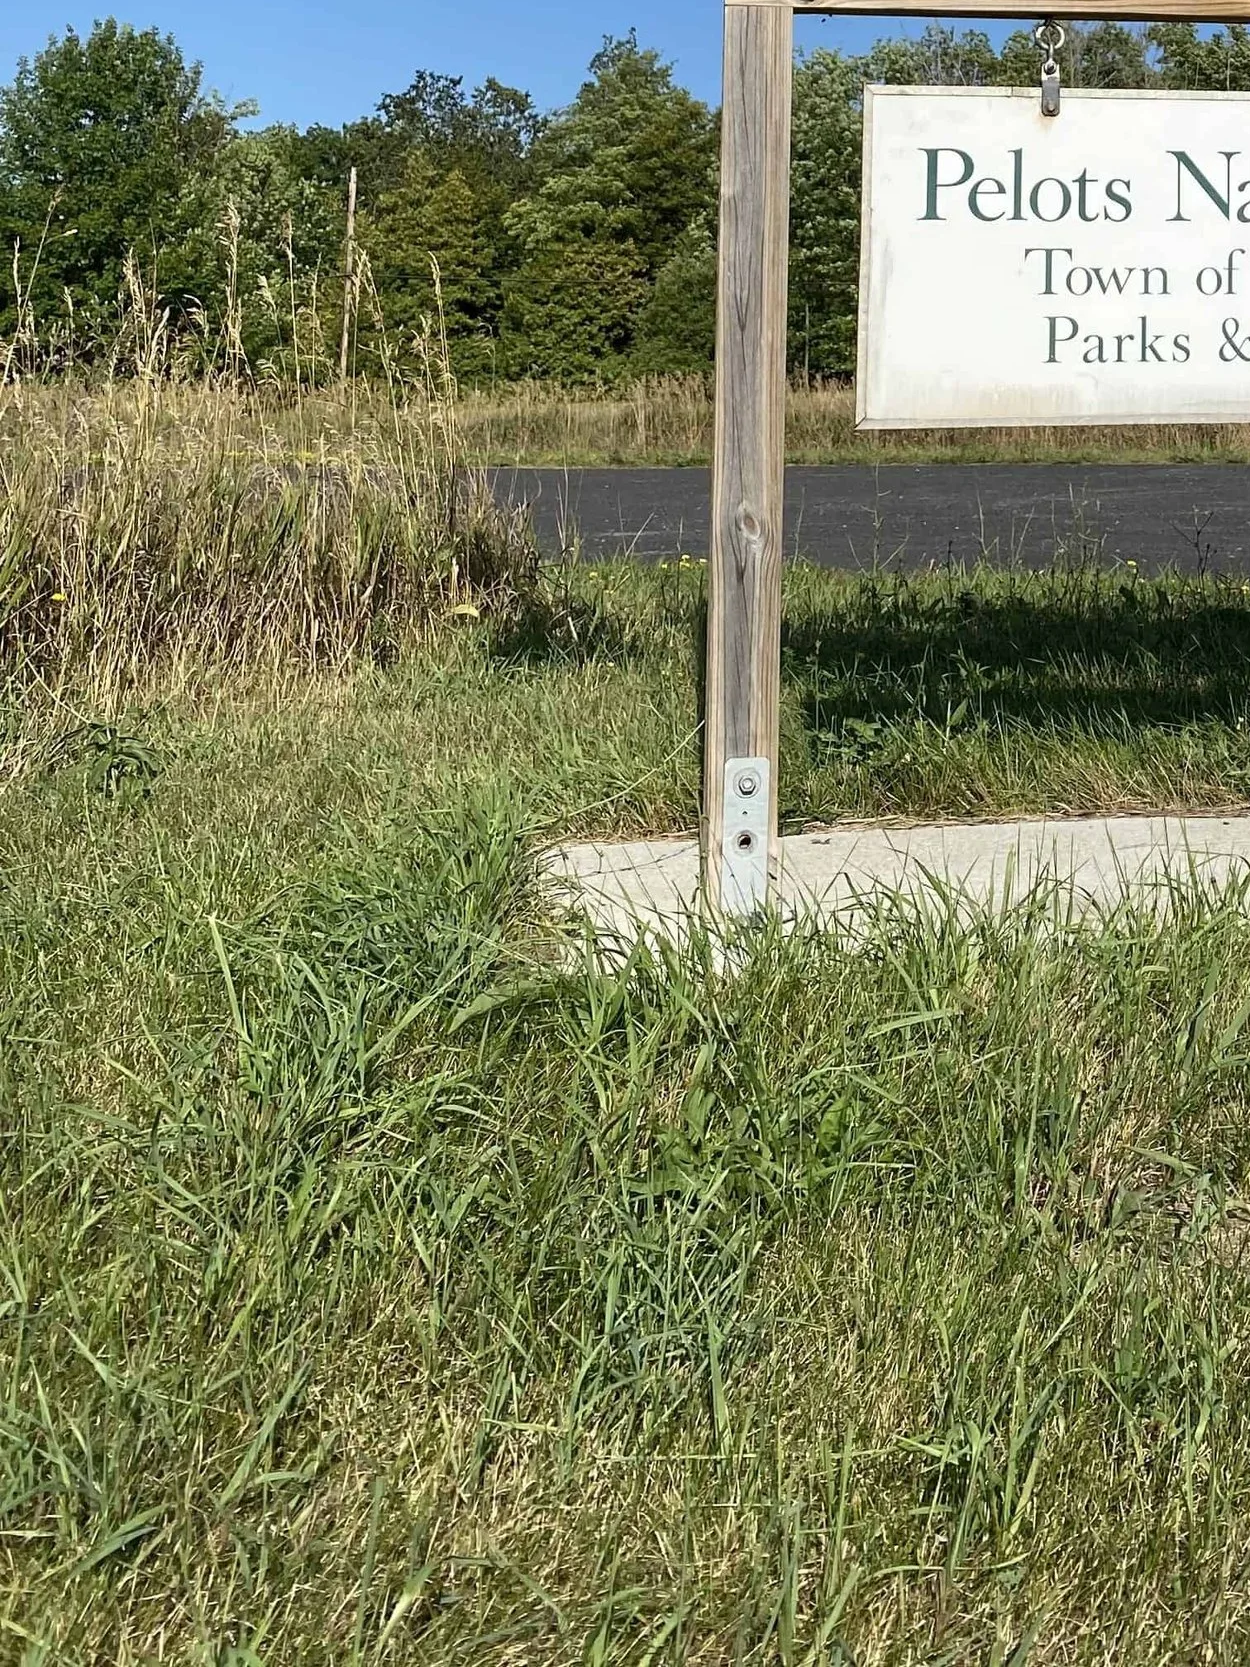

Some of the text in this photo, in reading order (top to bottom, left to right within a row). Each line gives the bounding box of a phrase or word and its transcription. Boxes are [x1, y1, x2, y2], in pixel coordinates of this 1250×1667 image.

[916, 148, 1133, 224] Pelots
[1024, 248, 1170, 296] Town
[1195, 248, 1245, 296] of
[1043, 315, 1191, 364] Parks
